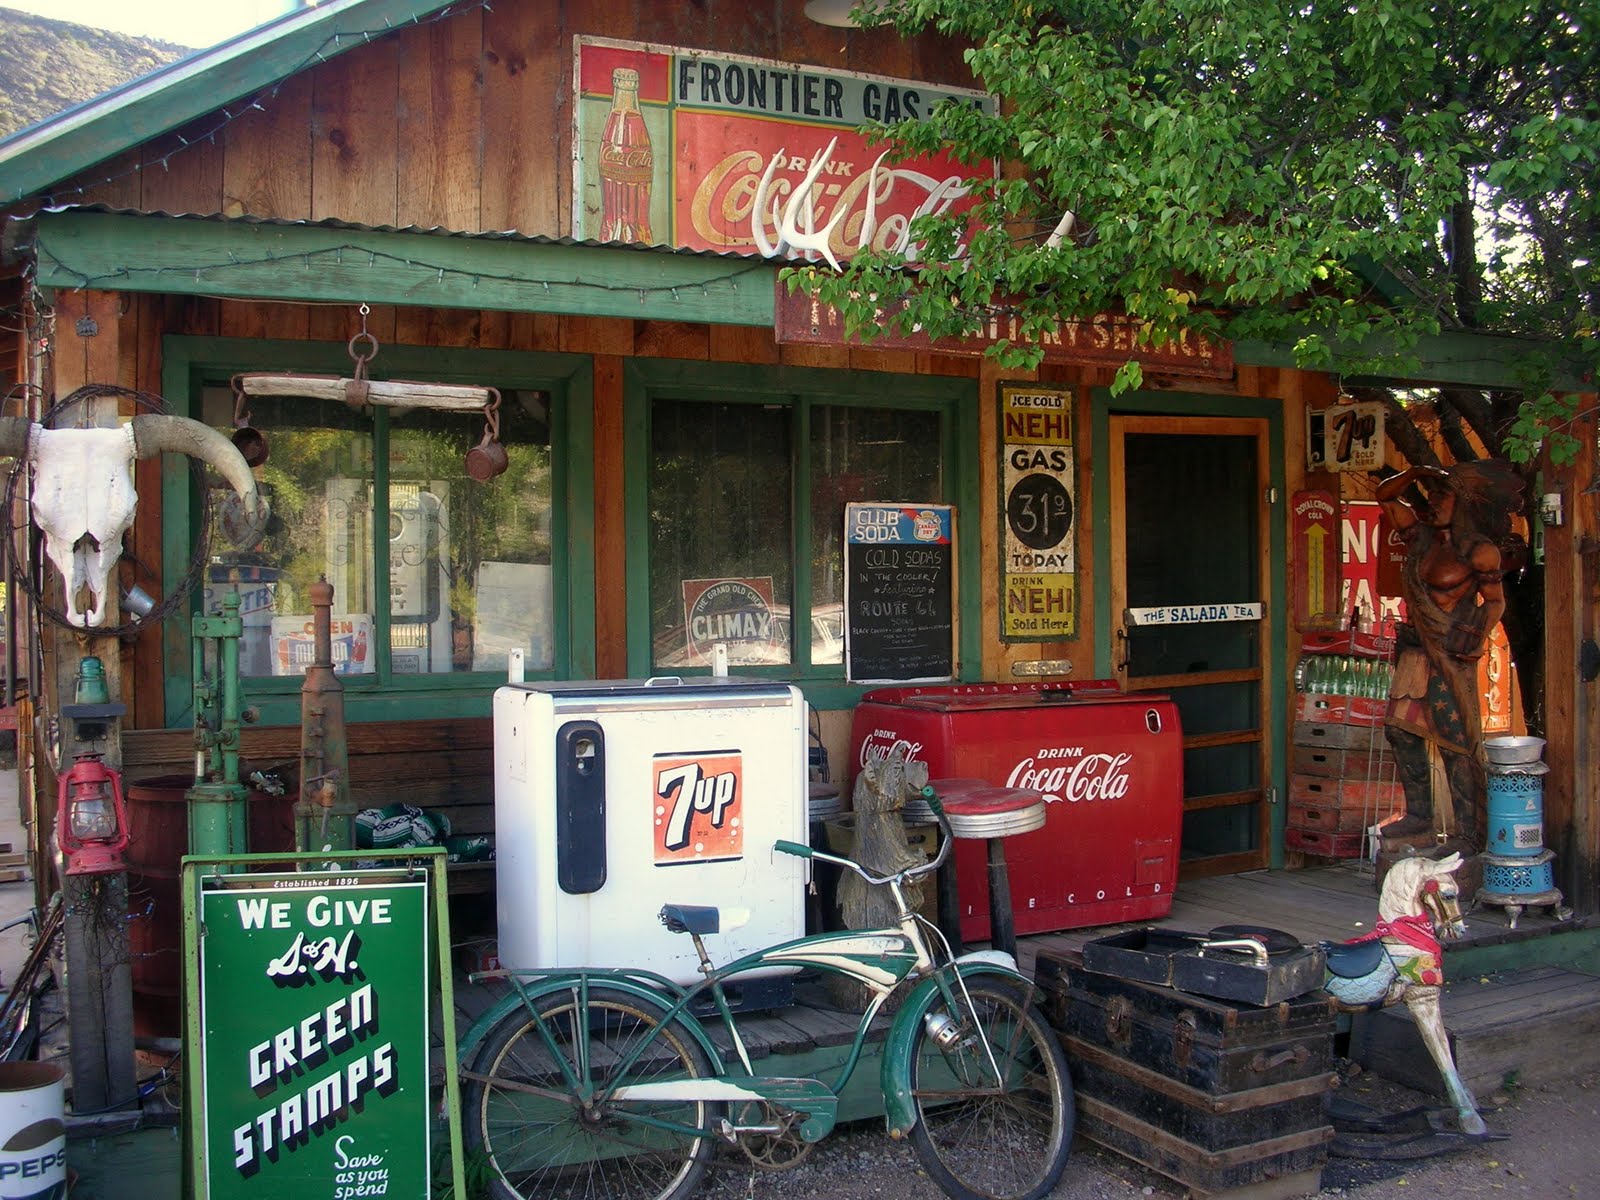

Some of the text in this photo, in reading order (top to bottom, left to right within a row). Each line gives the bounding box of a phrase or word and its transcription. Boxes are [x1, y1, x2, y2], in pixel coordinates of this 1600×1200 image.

[679, 60, 843, 118] FRONTIER
[773, 153, 855, 176] DRINK
[1013, 396, 1062, 408] ICE COLD
[1006, 411, 1070, 440] NEHI
[1011, 449, 1067, 472] GAS
[857, 509, 900, 526] CLUB
[855, 526, 901, 542] SODA
[865, 549, 942, 567] COLD SODAS
[1012, 554, 1069, 567] TODAY
[859, 573, 869, 583] IN
[874, 573, 891, 581] THE
[1012, 577, 1043, 586] DRINK
[696, 585, 765, 612] THE GRAND OLD CHEW
[1009, 588, 1072, 614] NEHI
[860, 600, 908, 617] ROUTE
[1144, 609, 1165, 622] THE
[1234, 606, 1254, 617] TEA
[303, 621, 353, 634] OEN
[692, 612, 770, 640] CLIMAX
[1012, 618, 1069, 631] Sold Here
[873, 728, 897, 739] DRINK
[1037, 747, 1083, 759] DRINK
[1005, 752, 1132, 804] Coca-Cola
[273, 877, 359, 888] Established 1896
[237, 895, 392, 930] WE GIVE
[250, 983, 373, 1088] GREEN
[234, 1041, 392, 1169] STAMPS
[334, 1135, 384, 1170] Save
[336, 1167, 389, 1190] as you
[334, 1180, 389, 1200] spend
